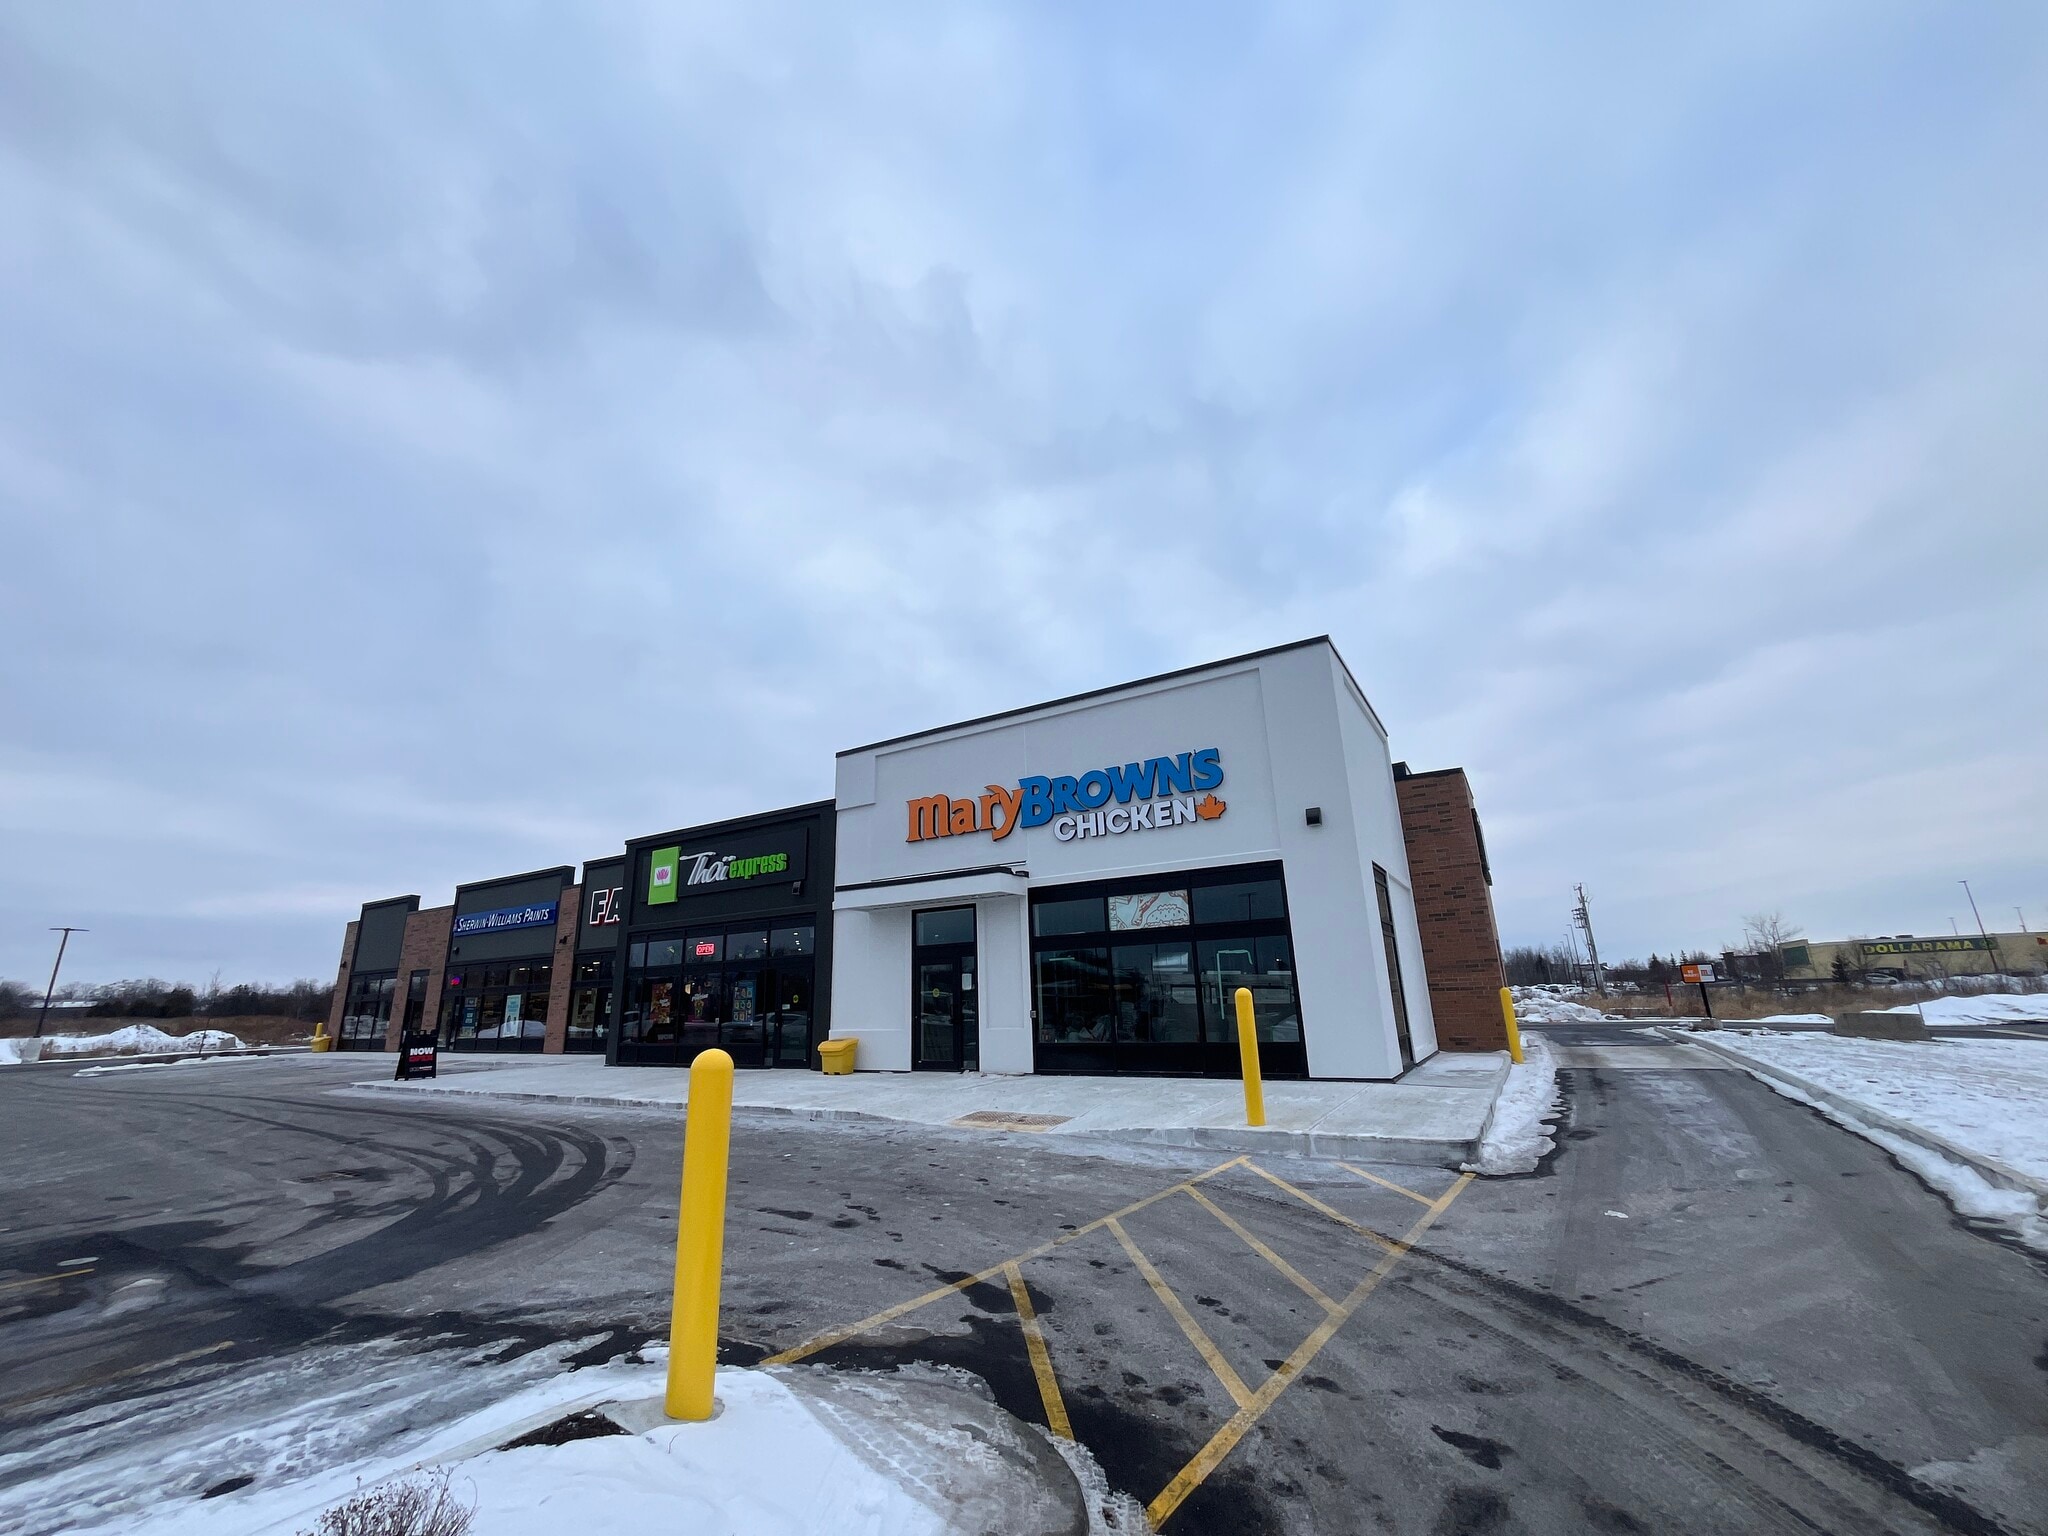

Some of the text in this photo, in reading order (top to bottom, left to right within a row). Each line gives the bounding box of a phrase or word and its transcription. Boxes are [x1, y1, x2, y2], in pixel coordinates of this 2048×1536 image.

[1053, 797, 1198, 843] CHICKEN
[729, 853, 788, 879] express
[457, 907, 550, 932] SHERWIN-WILLIAMS PAINTS
[697, 945, 714, 954] OPEN
[1863, 939, 1974, 954] DOLLARAMA
[409, 1047, 434, 1056] NOW
